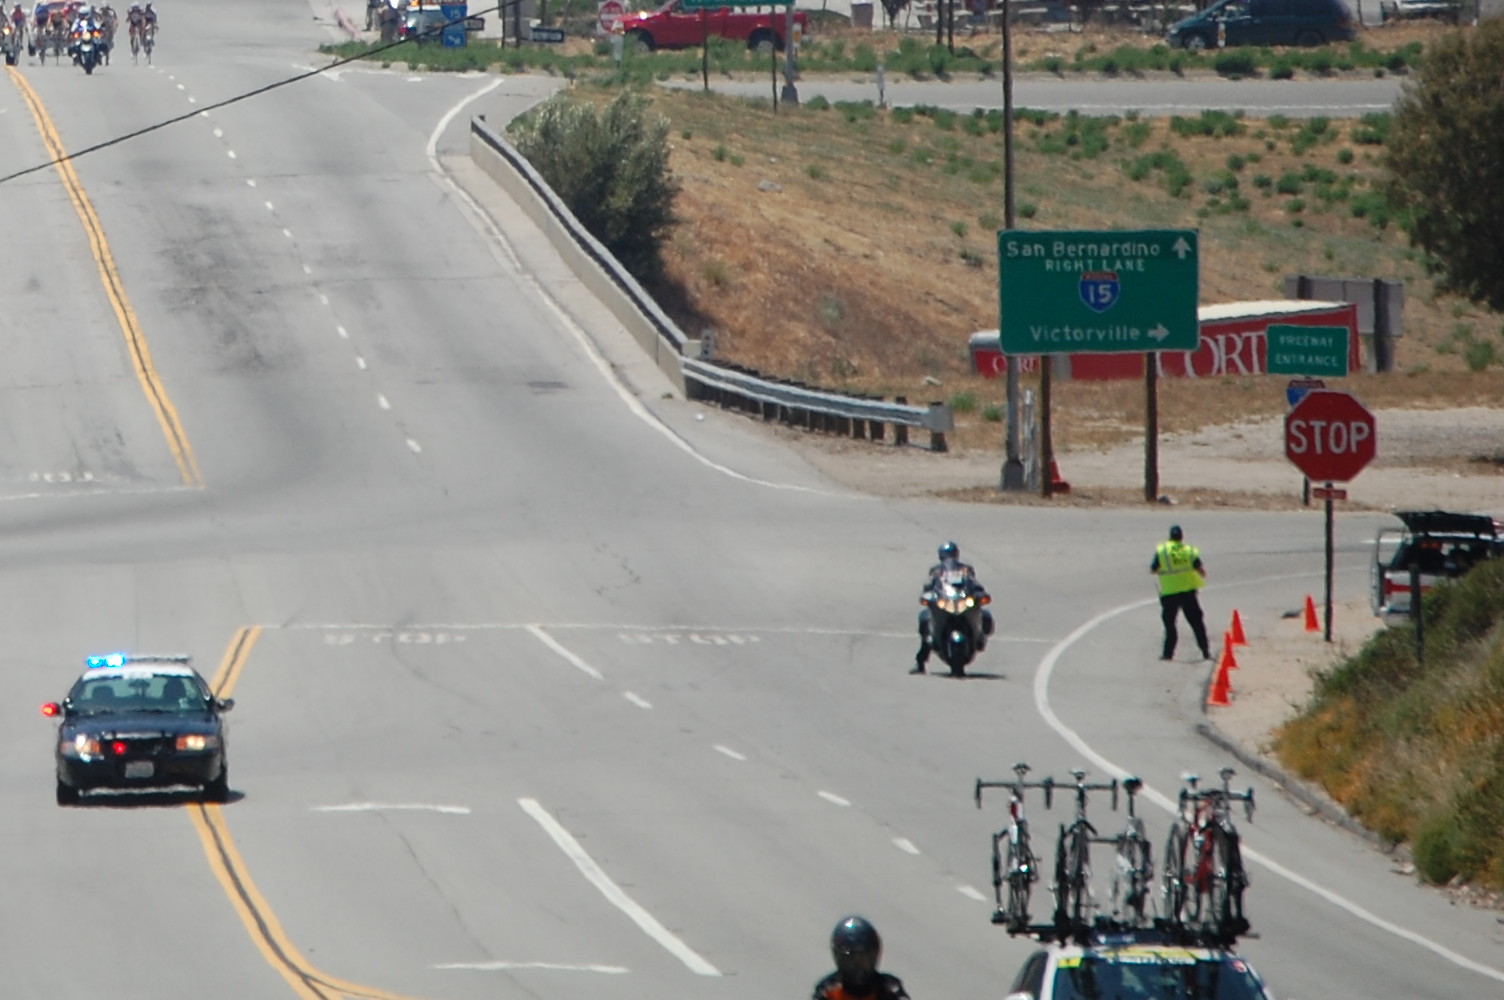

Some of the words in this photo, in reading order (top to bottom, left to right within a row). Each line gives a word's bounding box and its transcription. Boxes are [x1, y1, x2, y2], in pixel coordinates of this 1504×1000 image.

[1006, 241, 1045, 257] San
[1053, 240, 1161, 257] Bernardino
[1045, 259, 1094, 271] RIGHT
[1102, 259, 1145, 271] LANE
[1088, 284, 1113, 304] 15
[1029, 326, 1141, 341] Victorville
[1279, 335, 1334, 348] FREEWAY
[1275, 353, 1339, 367] ENTRANCE
[1289, 419, 1370, 454] STOP
